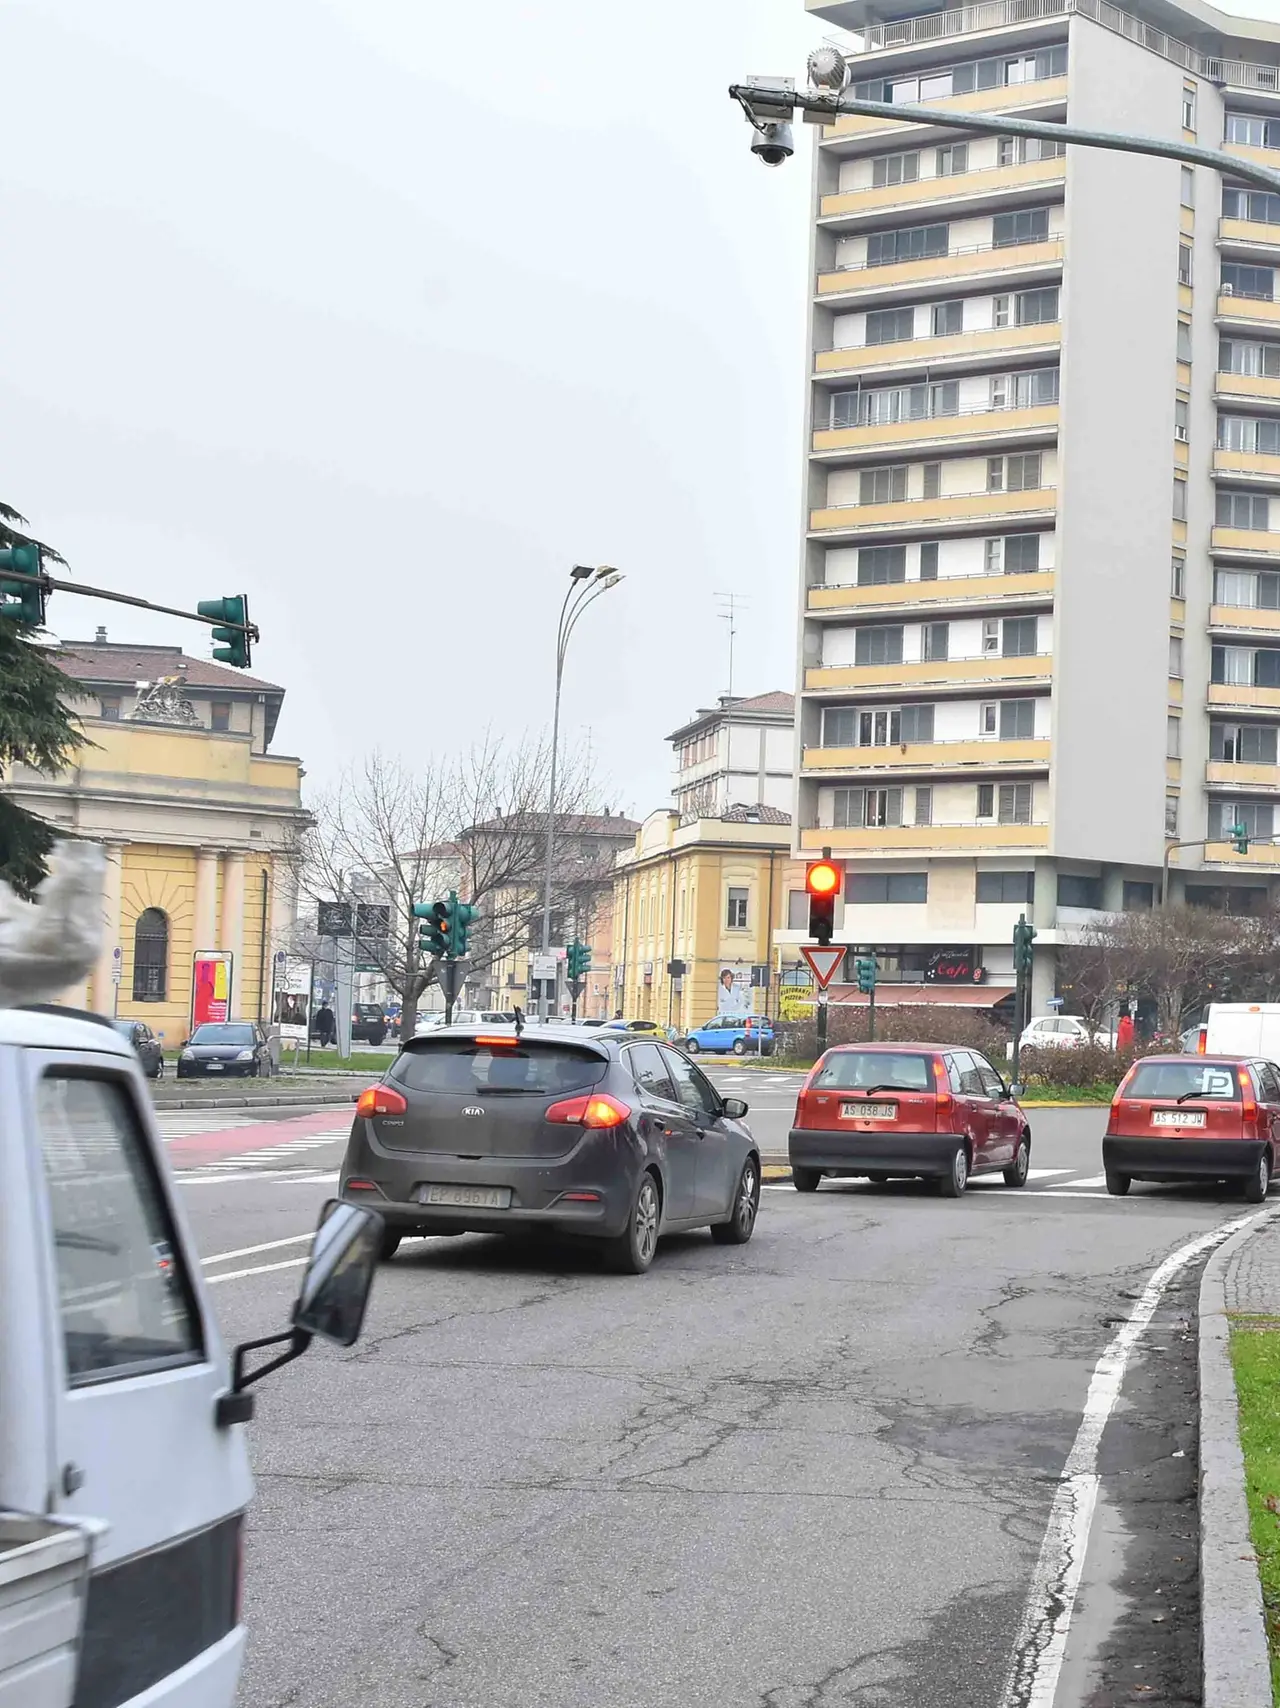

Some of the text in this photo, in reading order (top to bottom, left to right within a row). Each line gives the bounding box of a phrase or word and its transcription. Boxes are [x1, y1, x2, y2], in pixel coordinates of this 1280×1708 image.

[1208, 1075, 1229, 1093] P
[463, 1107, 482, 1116] KIA
[844, 1105, 894, 1118] AS 038 JS
[1155, 1111, 1167, 1123] AS
[1171, 1112, 1189, 1124] 512
